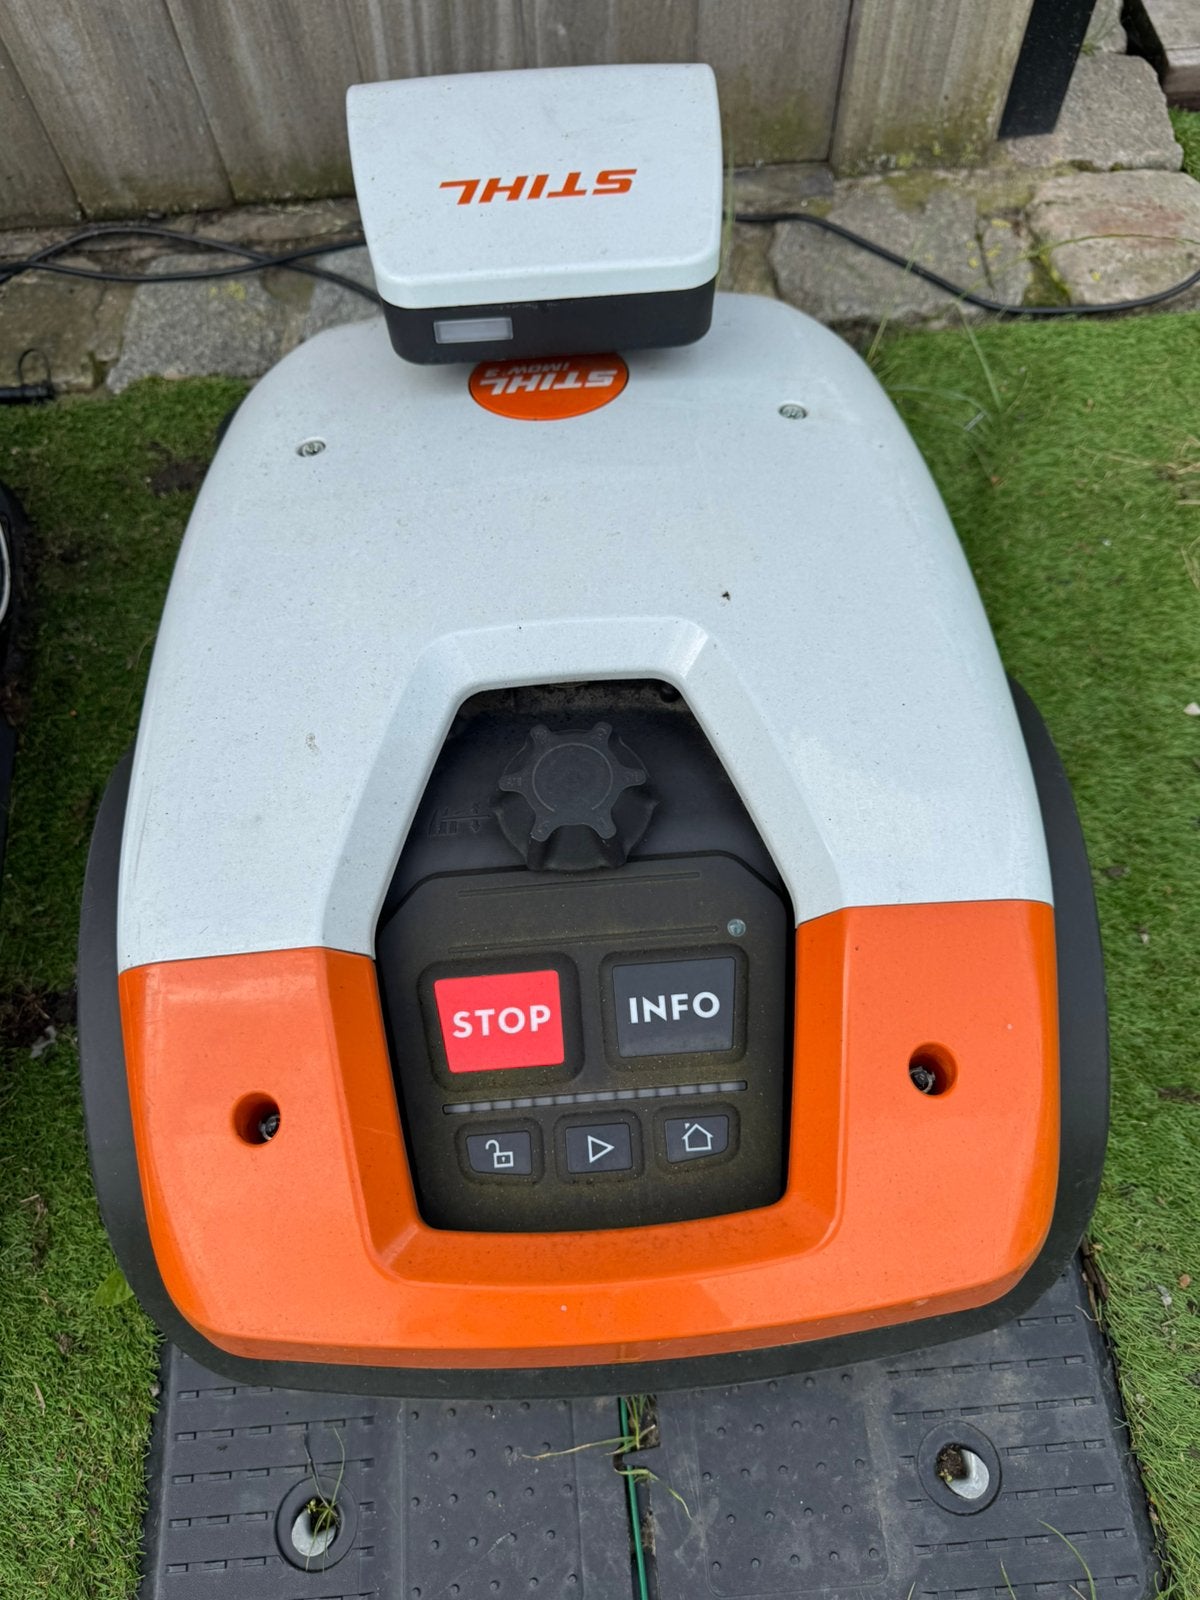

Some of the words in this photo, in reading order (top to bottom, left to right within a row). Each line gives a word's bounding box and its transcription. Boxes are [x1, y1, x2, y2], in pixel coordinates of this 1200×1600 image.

[439, 169, 637, 205] STIHL
[479, 370, 617, 395] STIHL
[452, 1004, 551, 1038] STOP
[628, 991, 721, 1024] INFO
